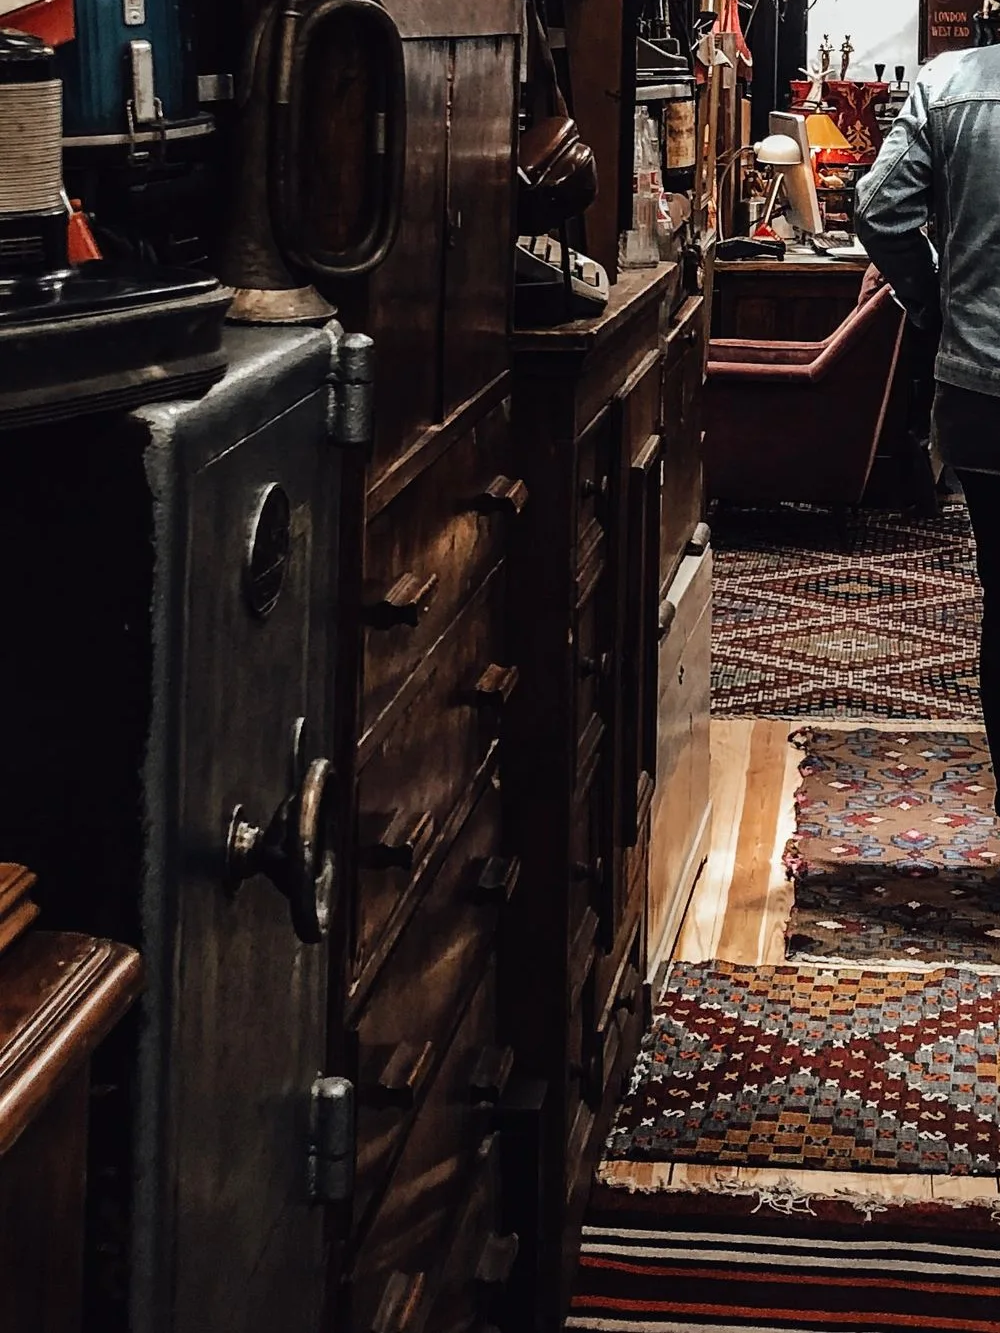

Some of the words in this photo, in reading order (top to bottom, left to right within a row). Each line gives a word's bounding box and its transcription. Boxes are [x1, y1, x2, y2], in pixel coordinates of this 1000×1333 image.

[934, 11, 968, 22] LONDON
[931, 26, 952, 36] WEST
[954, 26, 970, 37] END
